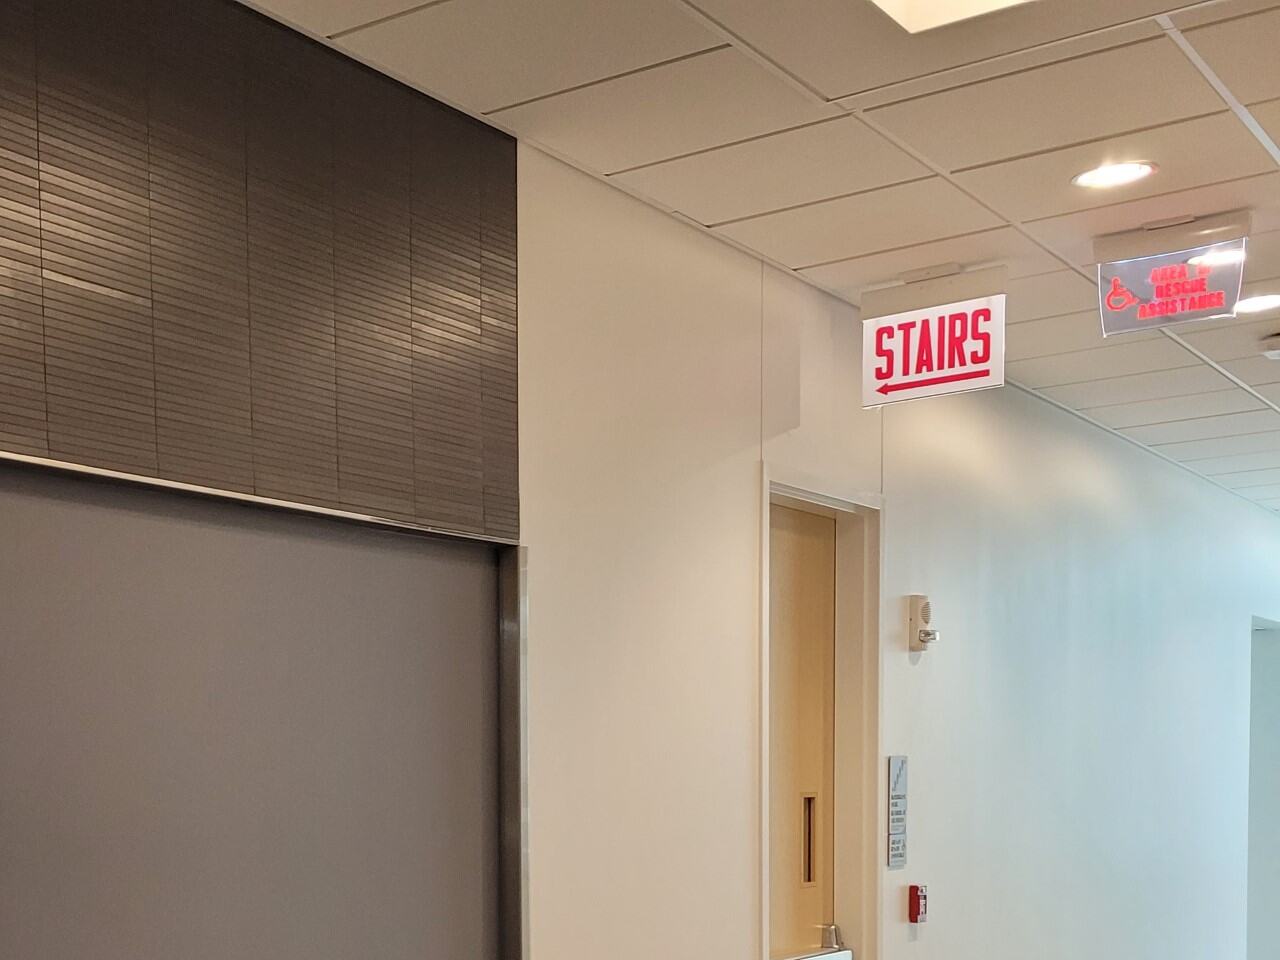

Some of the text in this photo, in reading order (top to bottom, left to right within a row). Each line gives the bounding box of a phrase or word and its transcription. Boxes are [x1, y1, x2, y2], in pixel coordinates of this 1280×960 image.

[1150, 263, 1188, 283] AREA
[1155, 278, 1208, 299] RESCUE
[1137, 290, 1225, 319] ASSISTANCE
[875, 307, 991, 381] STAIRS
